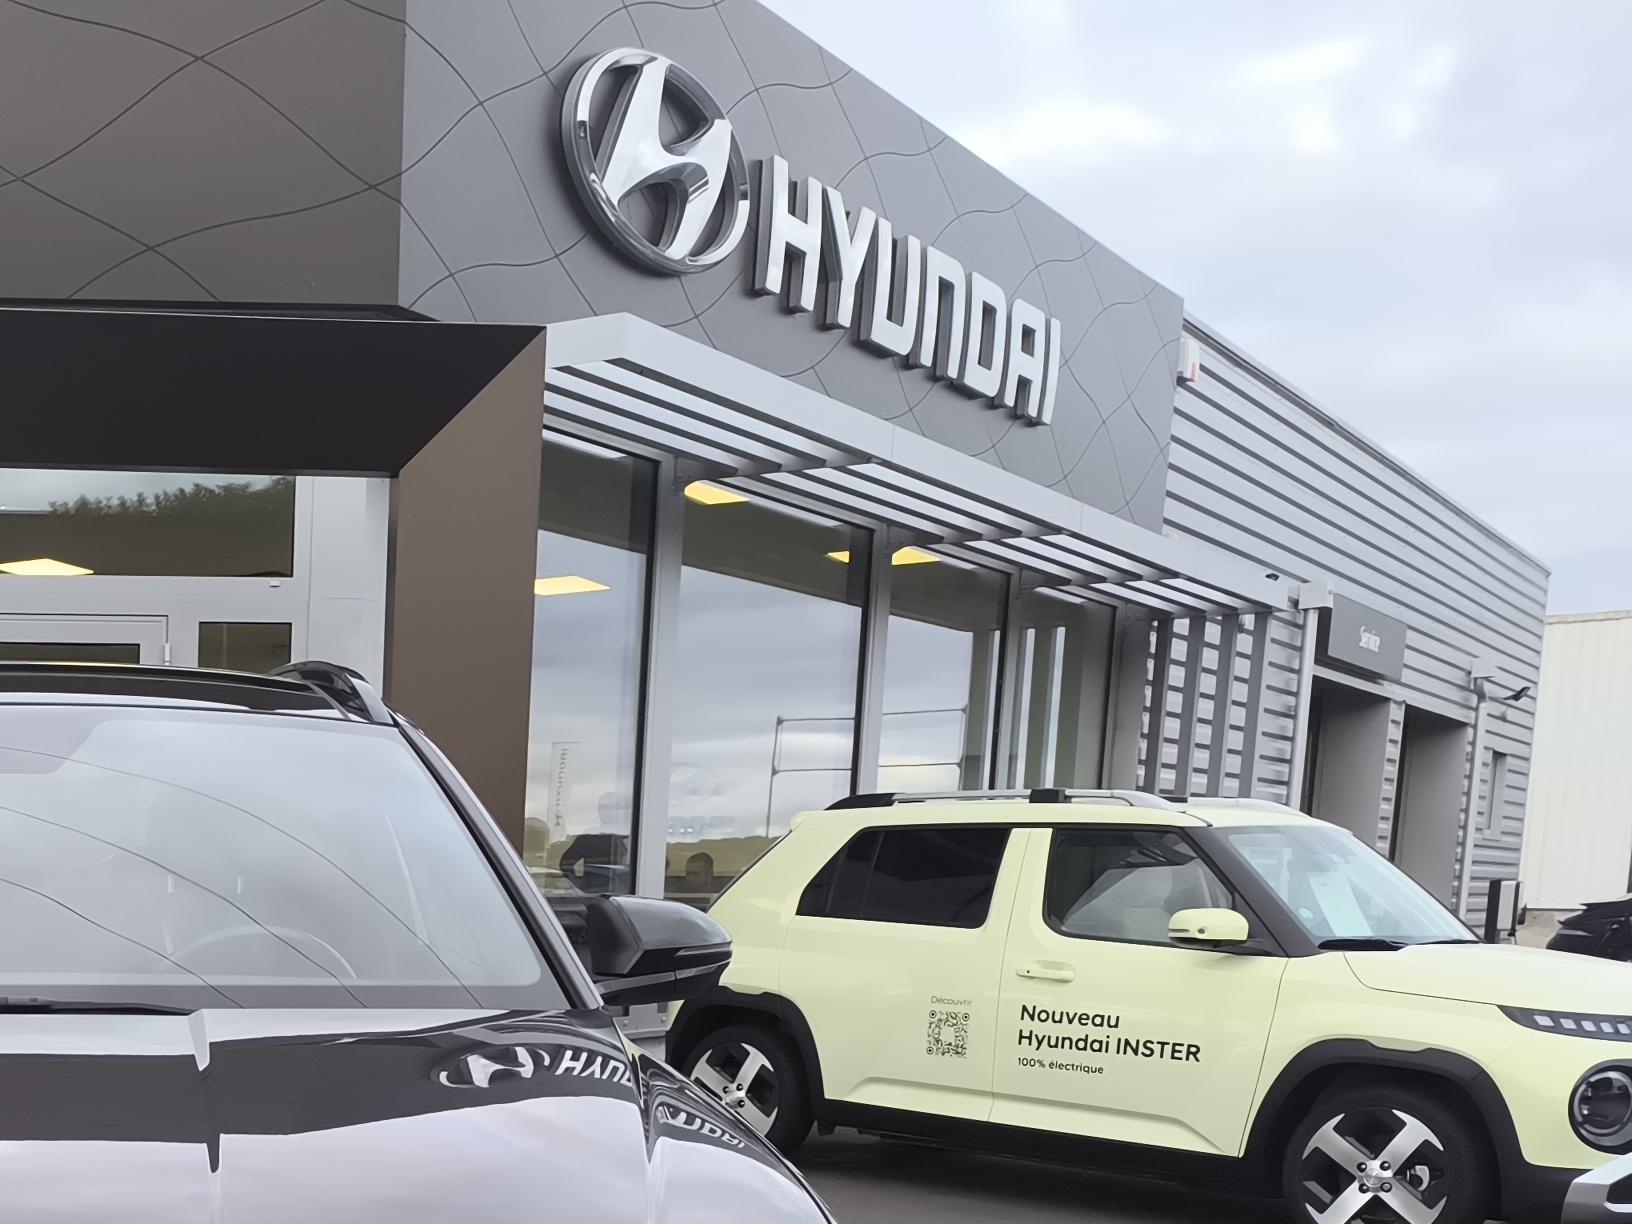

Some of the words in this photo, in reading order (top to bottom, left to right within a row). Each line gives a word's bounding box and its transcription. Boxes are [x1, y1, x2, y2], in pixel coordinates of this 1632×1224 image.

[753, 154, 1062, 427] HYUNDAI
[1020, 1004, 1120, 1029] Nouveau
[1018, 1029, 1110, 1055] Hyundai
[1116, 1037, 1201, 1062] INSTER
[1017, 1057, 1046, 1069] 100%
[1048, 1059, 1104, 1075] électrique
